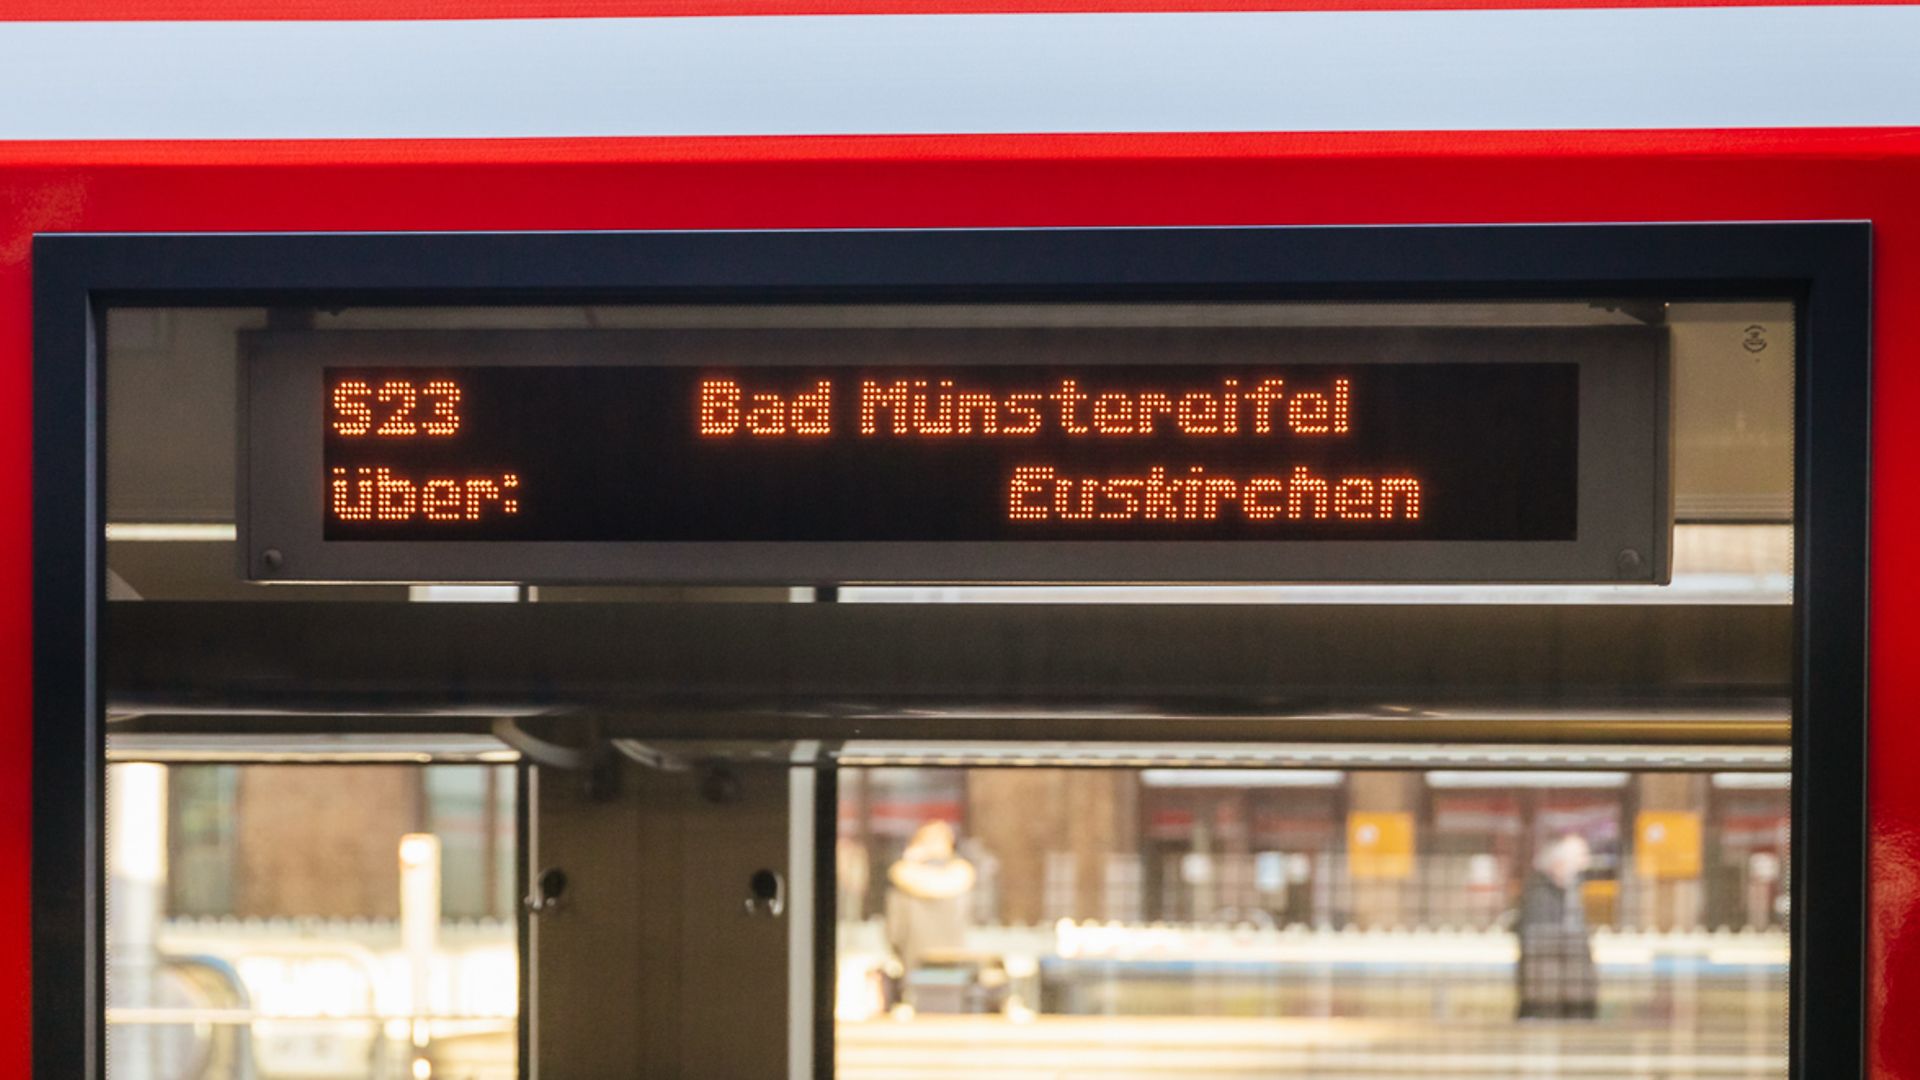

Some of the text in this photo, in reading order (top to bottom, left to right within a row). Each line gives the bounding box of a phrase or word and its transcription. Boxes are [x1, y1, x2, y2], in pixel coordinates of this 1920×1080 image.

[332, 381, 461, 436] S23
[700, 379, 1349, 436] Bad Münstereifel
[332, 467, 519, 520] über:
[1009, 466, 1421, 520] Euskirchen
